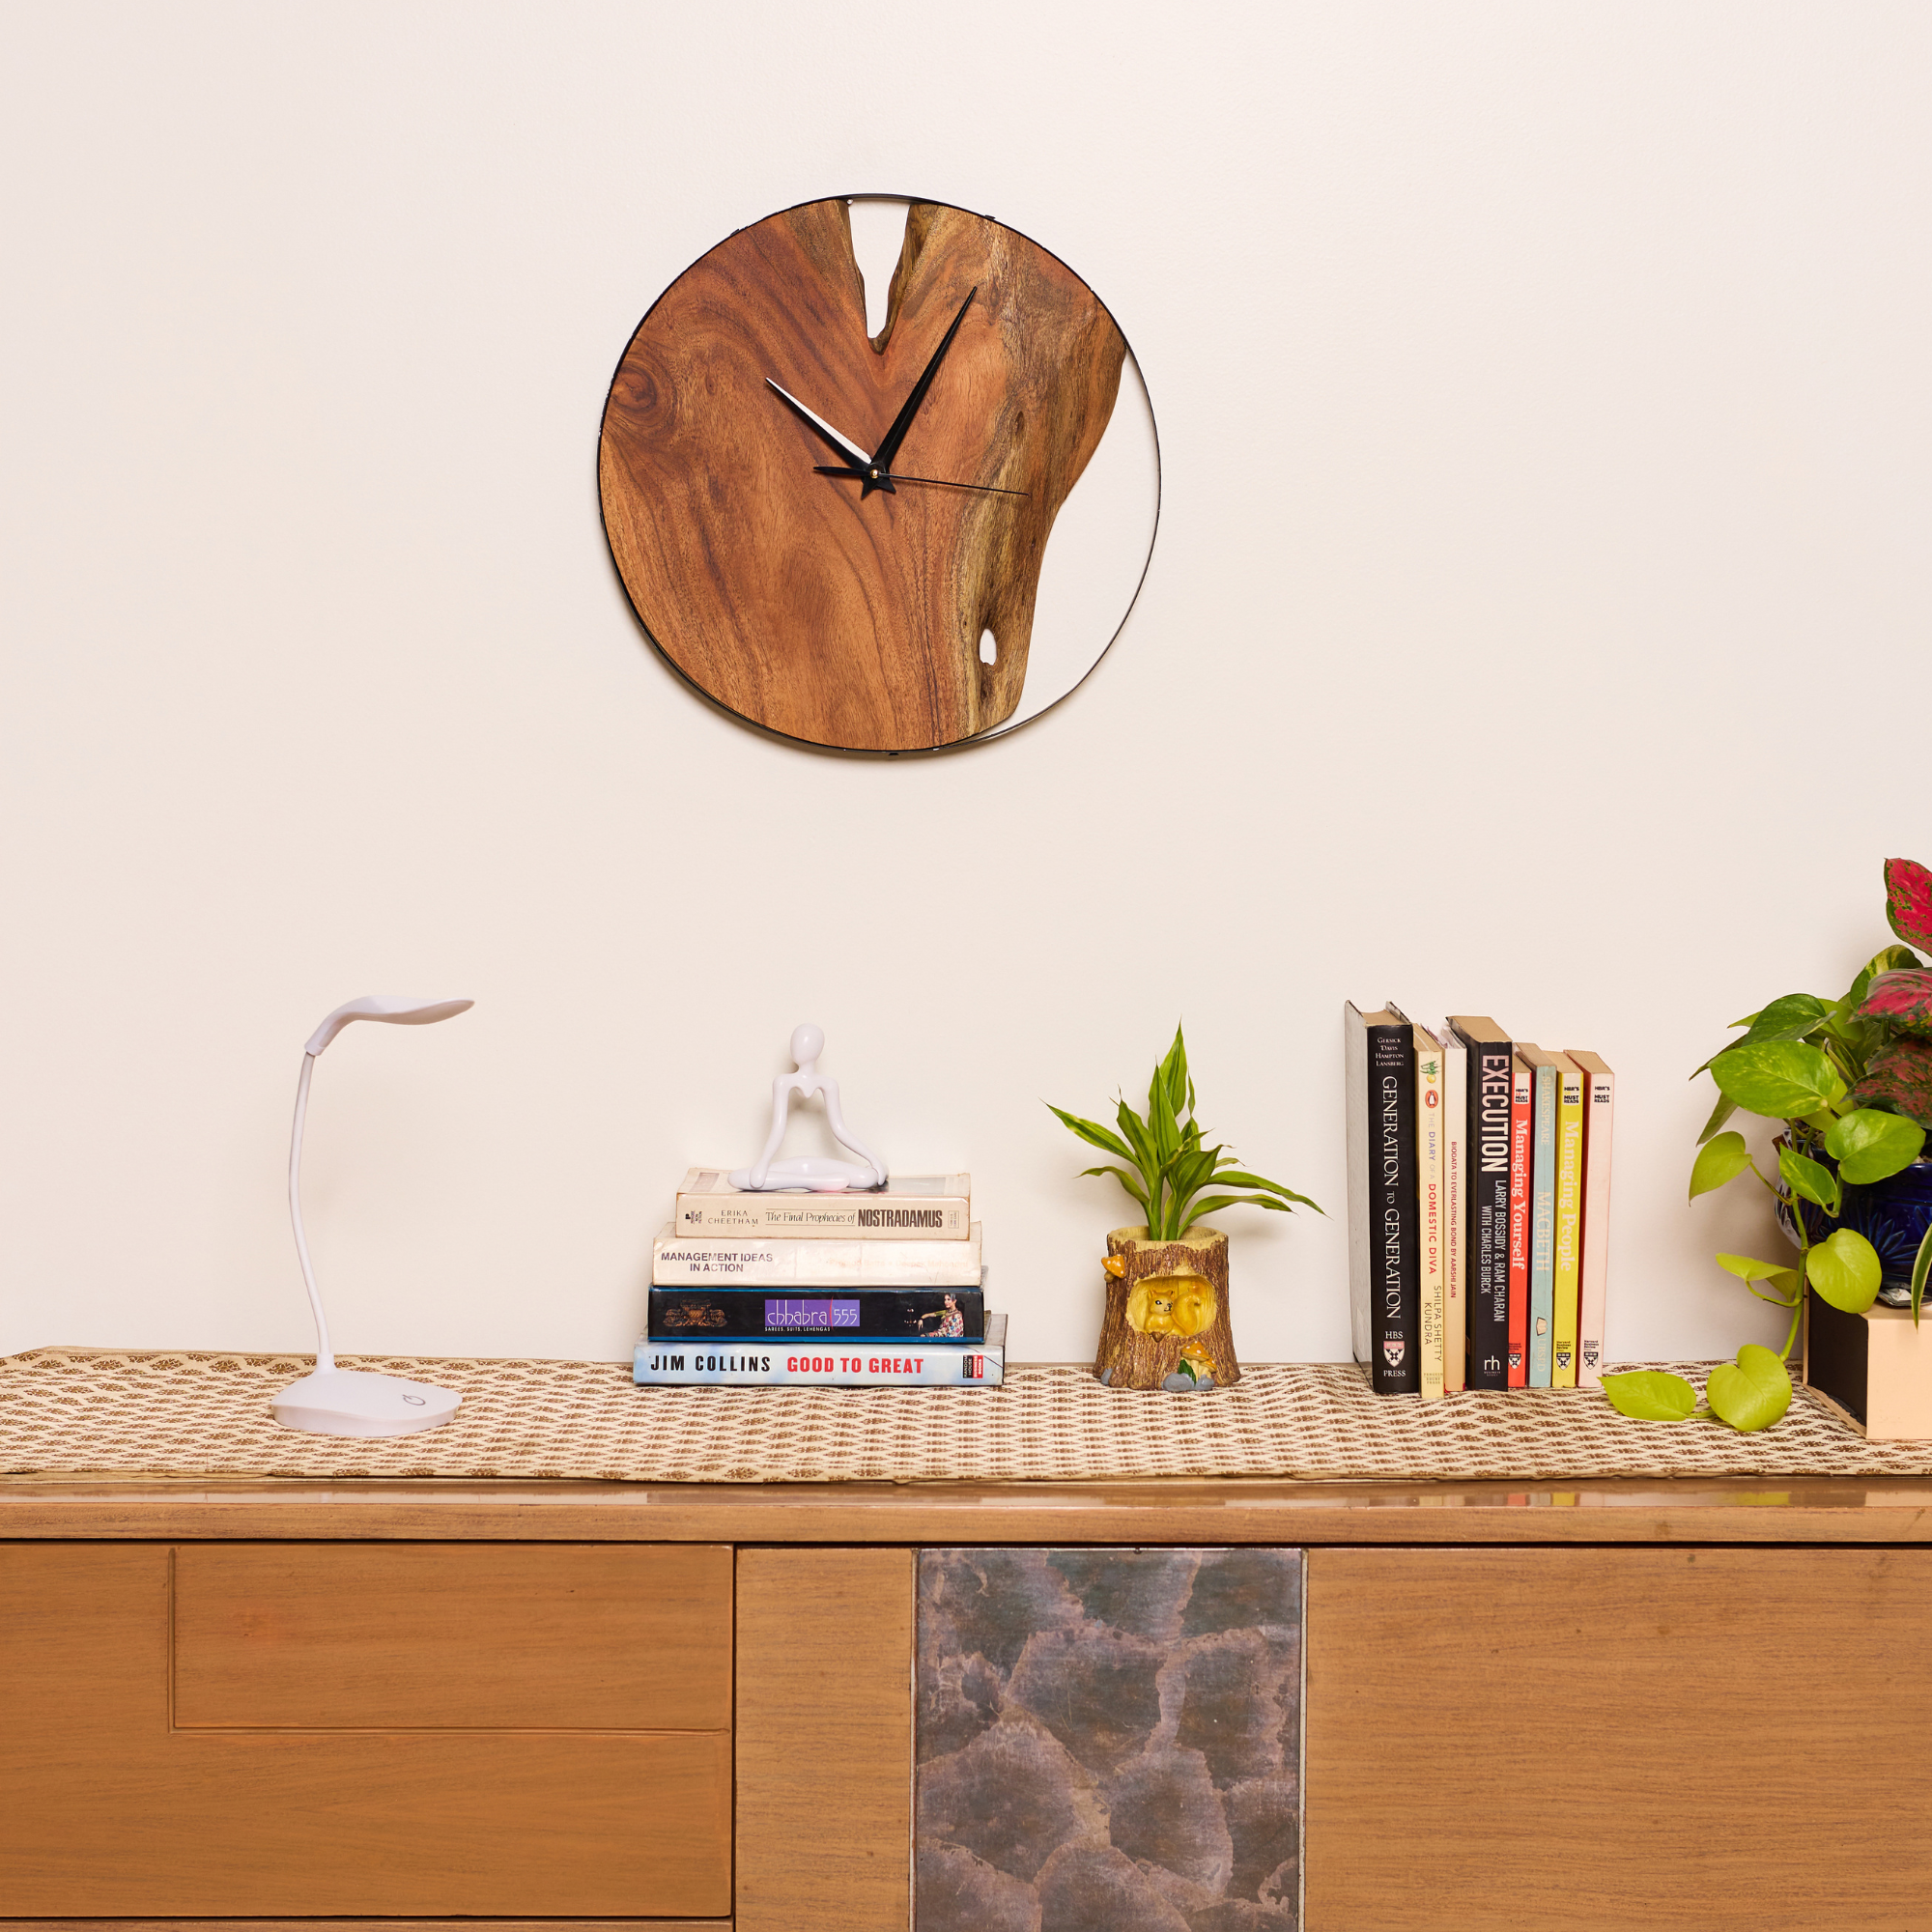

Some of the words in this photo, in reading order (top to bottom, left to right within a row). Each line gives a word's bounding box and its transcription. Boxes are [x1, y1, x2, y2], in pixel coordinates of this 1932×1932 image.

[1481, 1055, 1509, 1172] EXECUTION
[1541, 1076, 1551, 1146] SHAKESPEARE
[1382, 1075, 1400, 1186] GENERATION
[1428, 1131, 1436, 1161] DIARY
[1512, 1119, 1528, 1197] Managing
[1558, 1121, 1579, 1209] Managing
[1451, 1172, 1457, 1180] TO
[1386, 1191, 1395, 1205] TO
[1494, 1179, 1507, 1209] LARRY
[765, 1211, 781, 1222] The
[783, 1212, 804, 1222] Final
[806, 1212, 845, 1224] Prophecies
[846, 1212, 856, 1224] of
[858, 1208, 943, 1228] NOSTRADAMUS
[1428, 1183, 1436, 1242] DOMESTIC
[1481, 1206, 1492, 1226] WITH
[1481, 1228, 1492, 1264] CHARLES
[1494, 1211, 1507, 1251] BOSSIDY
[1512, 1201, 1526, 1270] Yourself
[1536, 1191, 1551, 1271] MACBETH
[1557, 1212, 1577, 1271] People
[661, 1252, 738, 1262] MANAGEMENT
[740, 1253, 773, 1263] IDEAS
[703, 1264, 744, 1272] ACTION
[1384, 1208, 1402, 1319] GENERATION
[1429, 1247, 1437, 1274] DIVA
[1493, 1263, 1505, 1283] RAM
[1480, 1266, 1492, 1294] BURCK
[767, 1299, 828, 1325] chhabra
[834, 1309, 858, 1325] 555
[1434, 1285, 1442, 1321] SHILPA
[1493, 1285, 1505, 1321] CHARAN
[1384, 1330, 1404, 1340] HBS
[1424, 1302, 1433, 1345] KUNDRA
[1434, 1323, 1442, 1362] SHETTY
[1537, 1338, 1547, 1372] UBSPD
[650, 1355, 685, 1371] JIM
[695, 1355, 771, 1372] COLLINS
[787, 1356, 834, 1373] GOOD
[840, 1357, 862, 1373] TO
[868, 1358, 923, 1374] GREAT
[1383, 1369, 1406, 1378] PRESS
[1484, 1354, 1500, 1371] rh
